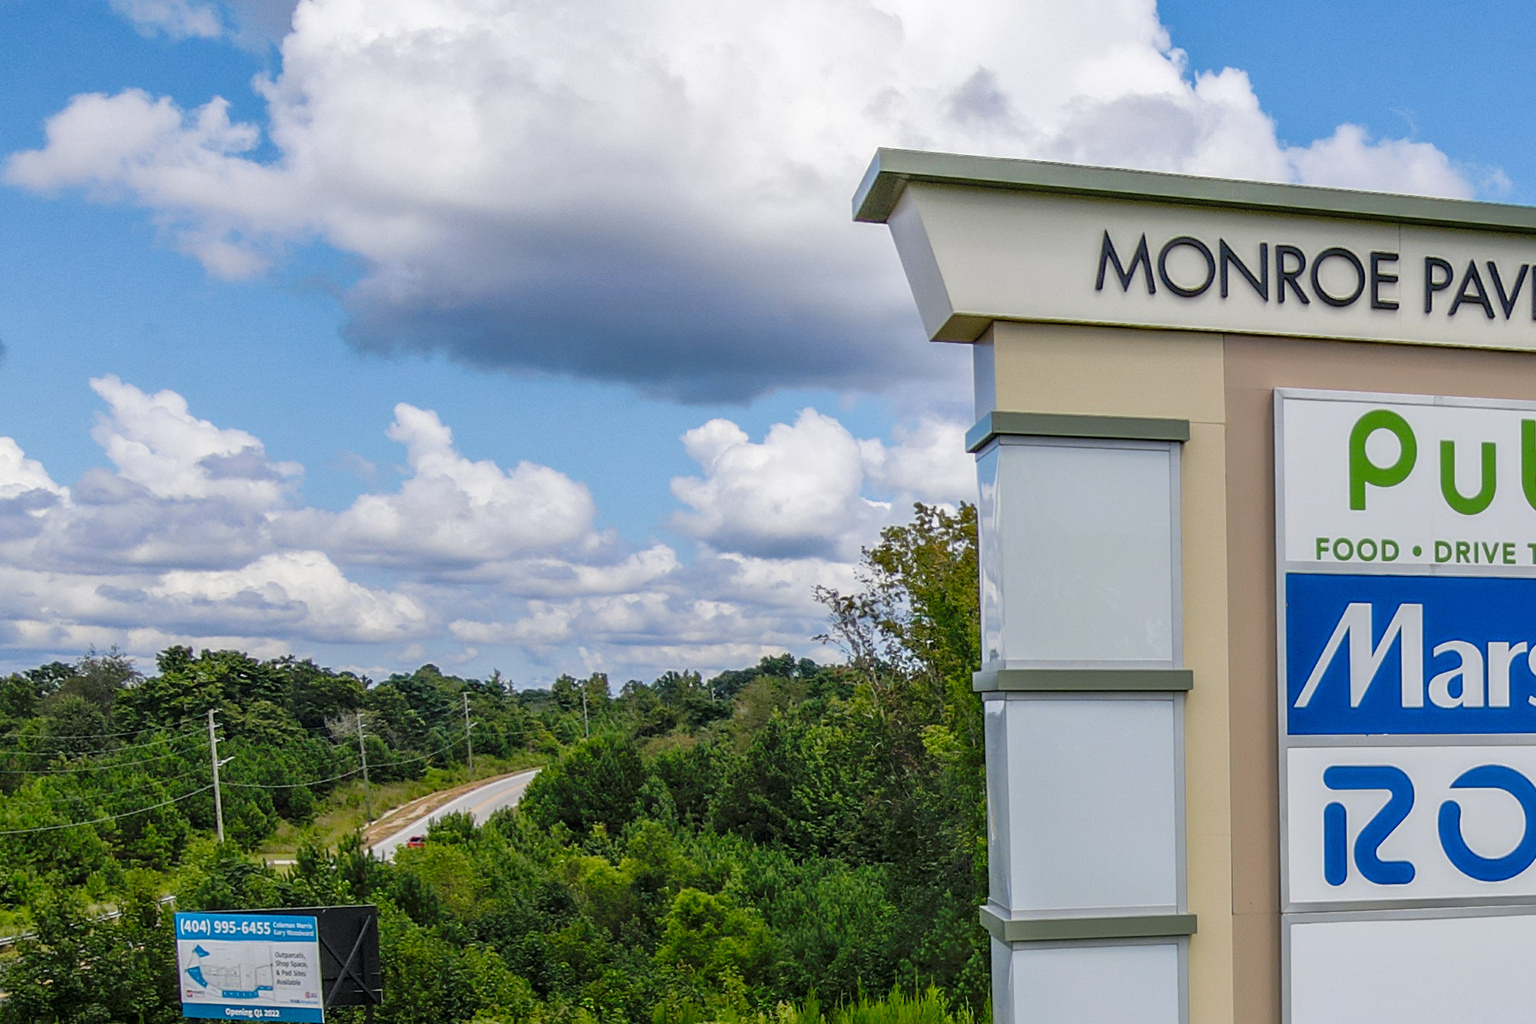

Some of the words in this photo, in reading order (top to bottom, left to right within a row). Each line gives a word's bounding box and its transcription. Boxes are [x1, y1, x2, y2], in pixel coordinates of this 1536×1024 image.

[1095, 229, 1400, 310] MONROE
[1315, 536, 1400, 562] FOOD
[1433, 540, 1517, 565] DRIVE
[180, 918, 211, 936] (404)
[214, 921, 271, 935] 995-6455
[275, 960, 288, 968] Shop
[225, 1008, 254, 1018] Opening
[254, 1009, 263, 1018] Q1
[263, 1009, 280, 1017] 2022
